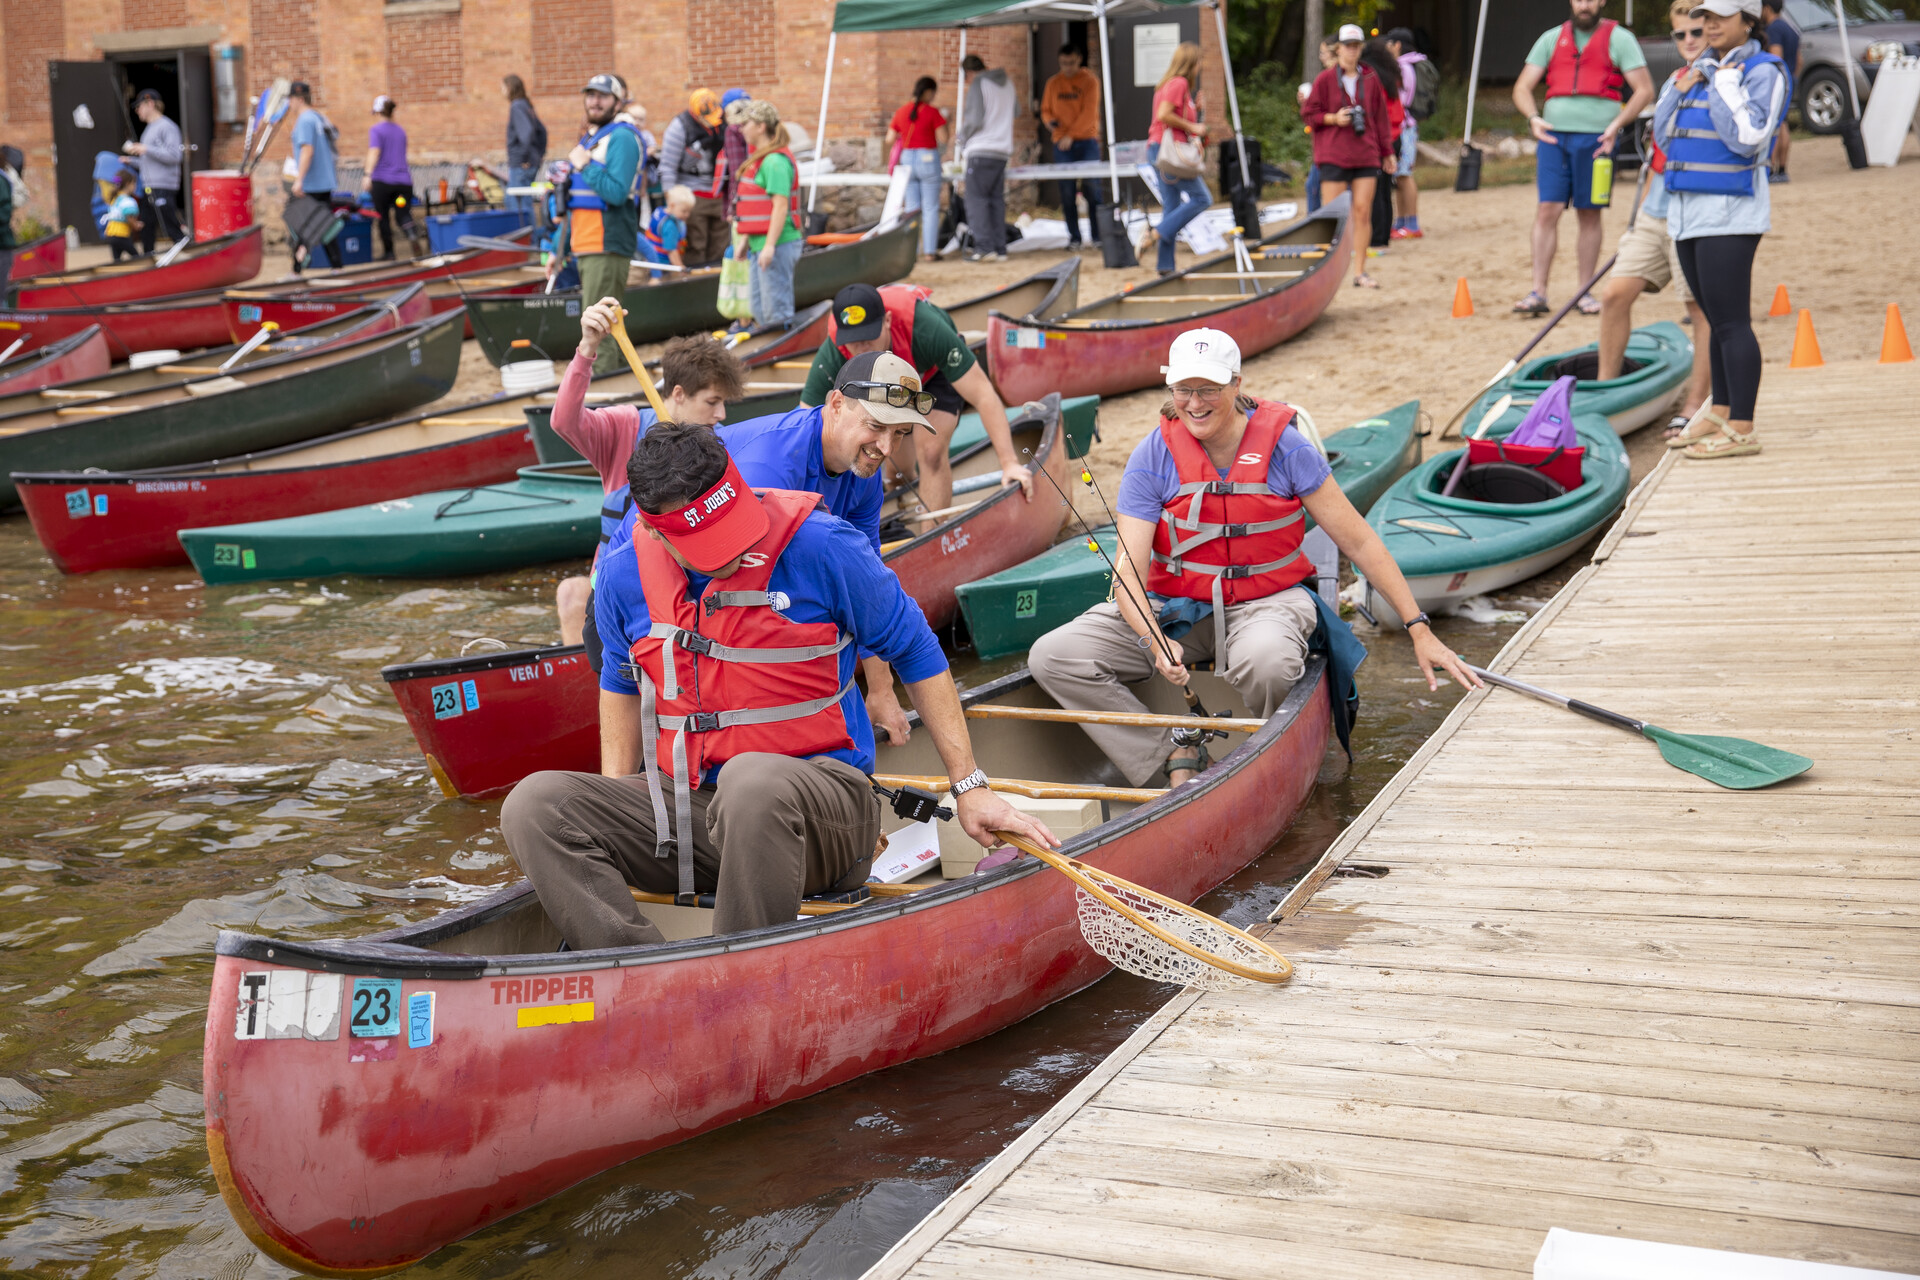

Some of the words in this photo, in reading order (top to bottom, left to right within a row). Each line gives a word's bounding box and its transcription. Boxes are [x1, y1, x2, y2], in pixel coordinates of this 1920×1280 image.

[136, 481, 188, 493] DISCOVERY
[68, 493, 86, 510] 23
[683, 507, 705, 528] ST.
[703, 481, 737, 514] JOHN'S
[215, 548, 235, 562] 23
[1017, 594, 1033, 612] 23
[433, 689, 456, 713] 23
[913, 800, 925, 817] ORVIS
[490, 975, 594, 1005] TRIPPER
[243, 974, 267, 1035] T
[352, 988, 391, 1026] 23
